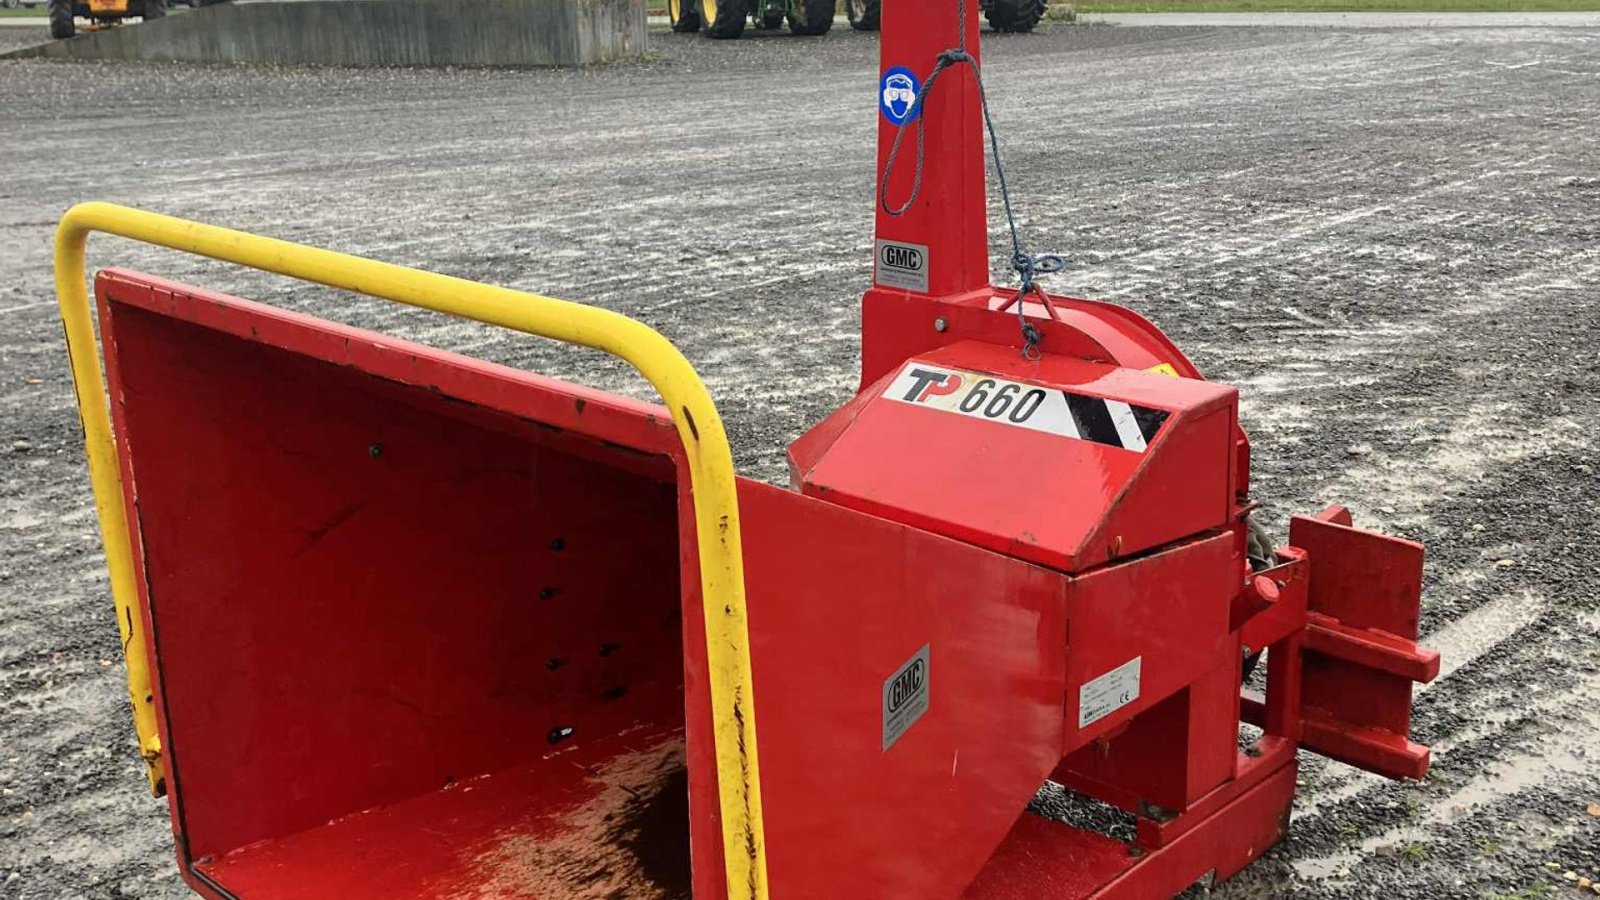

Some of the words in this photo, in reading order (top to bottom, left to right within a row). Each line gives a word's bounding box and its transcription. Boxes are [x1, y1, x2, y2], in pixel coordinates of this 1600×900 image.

[887, 247, 917, 268] GMC
[903, 368, 960, 402] TP
[960, 379, 1046, 423] 660
[894, 664, 920, 707] GMC
